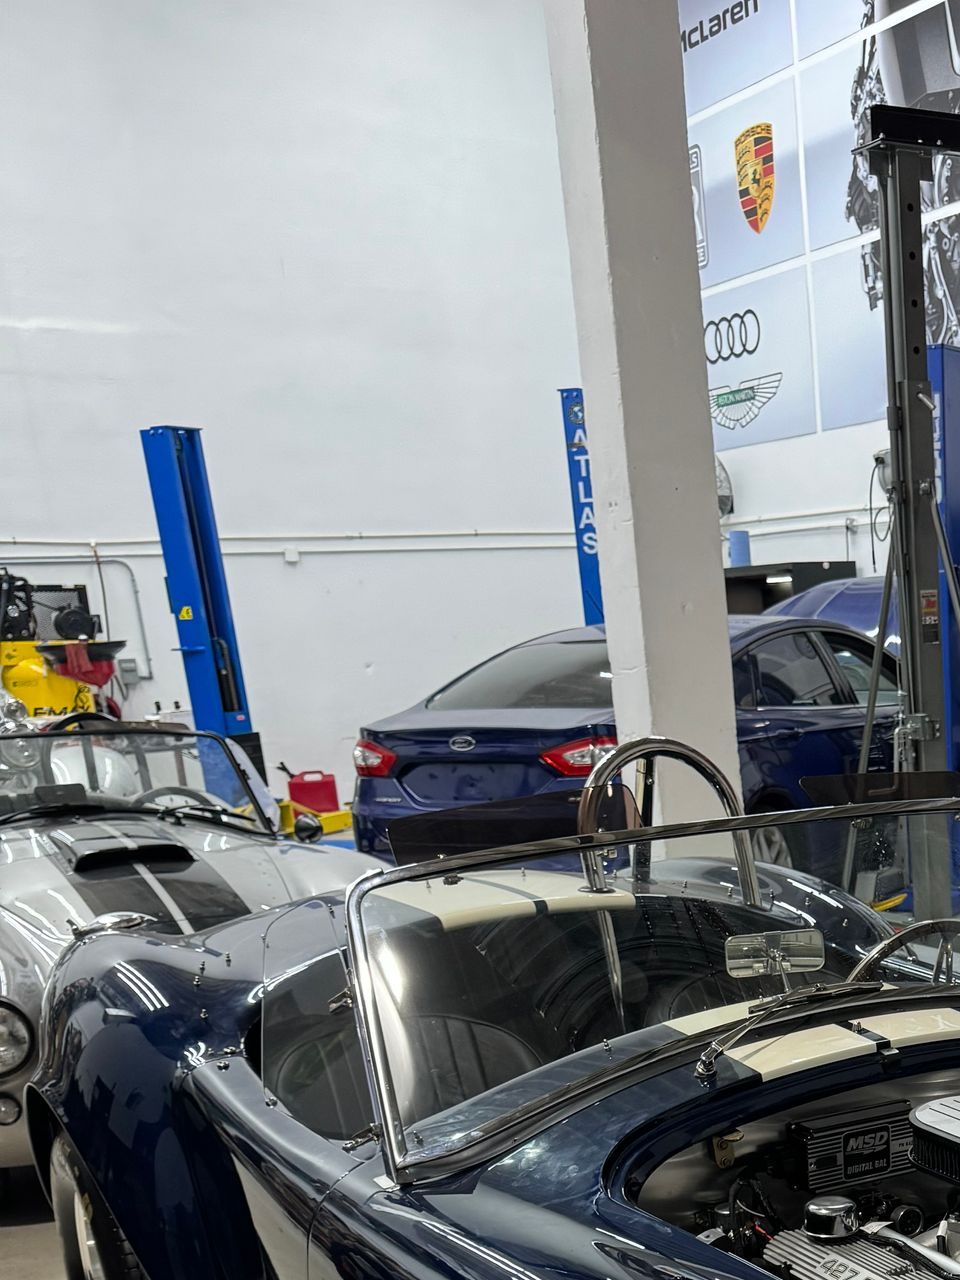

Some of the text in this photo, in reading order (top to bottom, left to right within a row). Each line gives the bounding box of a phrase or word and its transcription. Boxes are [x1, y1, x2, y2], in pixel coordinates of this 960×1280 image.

[572, 428, 599, 555] ATLAS
[846, 1131, 889, 1152] MSD
[847, 1162, 873, 1175] DIGITAL
